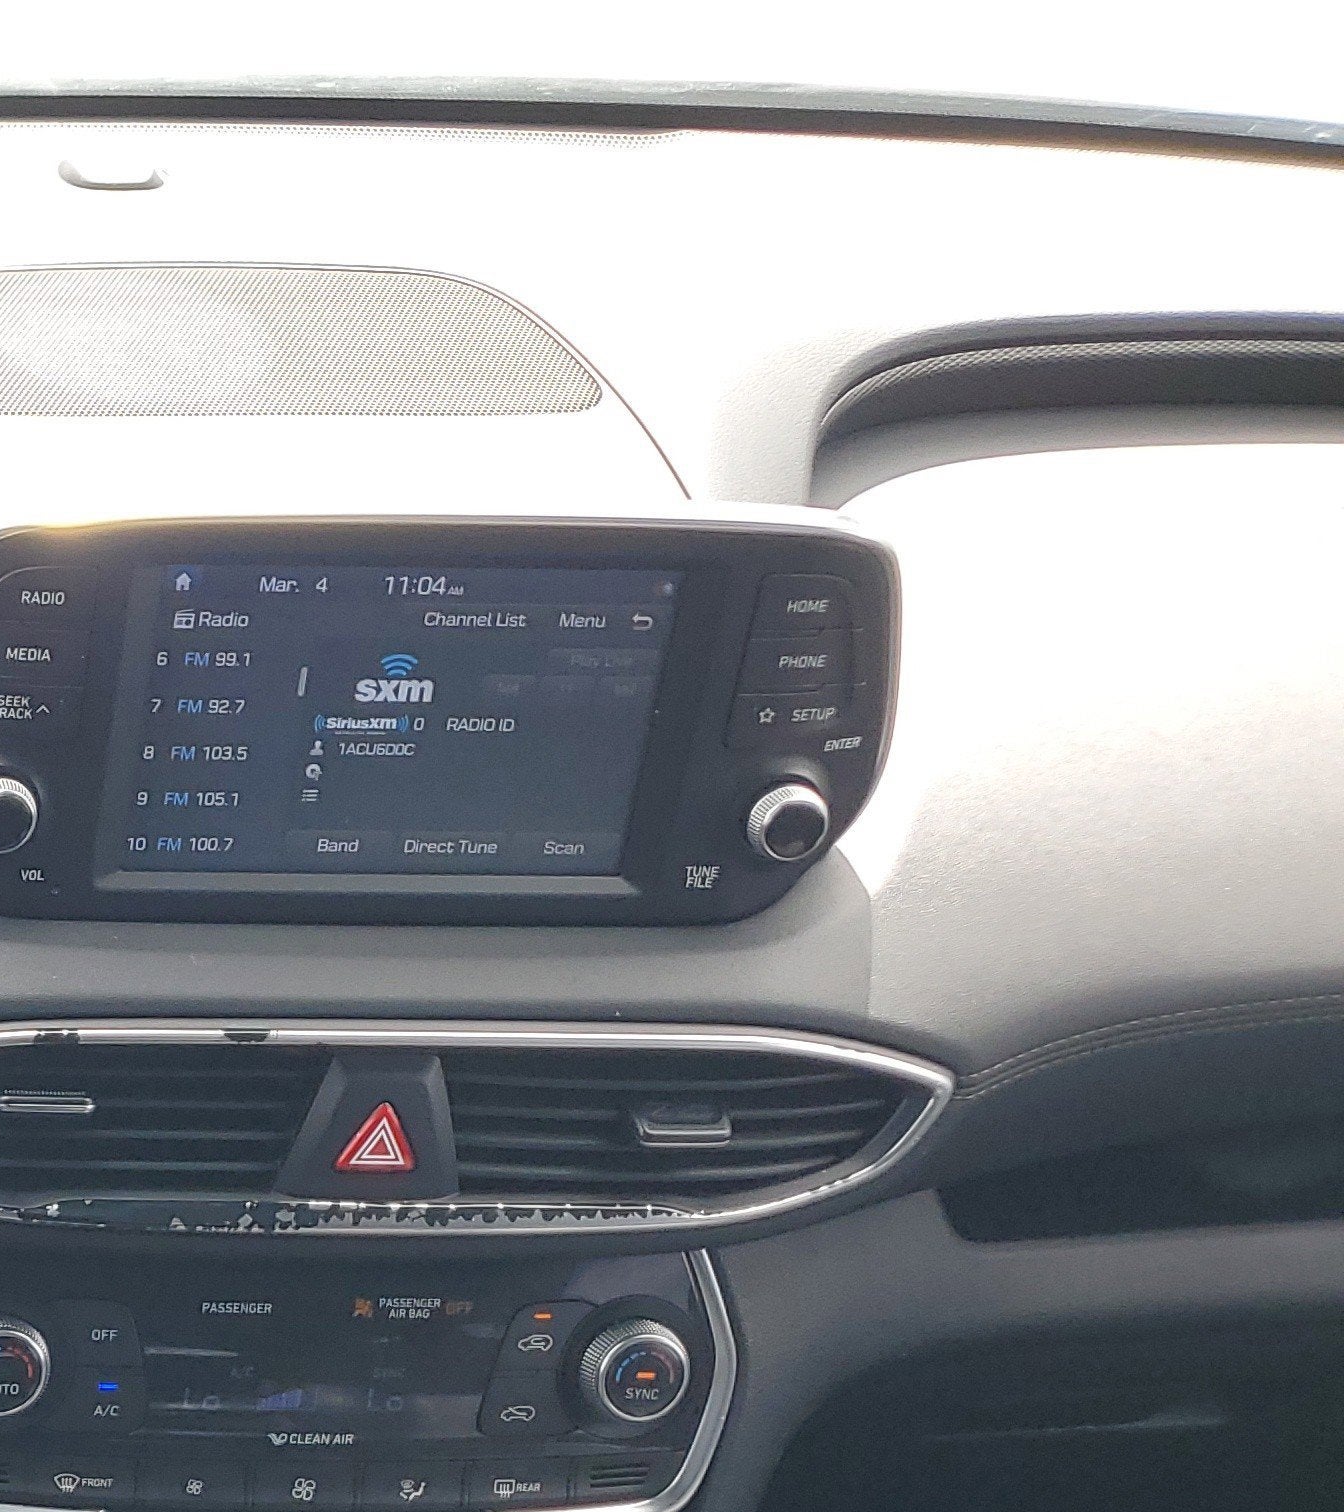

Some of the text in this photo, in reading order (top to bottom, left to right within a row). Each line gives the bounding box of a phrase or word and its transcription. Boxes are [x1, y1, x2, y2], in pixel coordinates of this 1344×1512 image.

[259, 577, 328, 593] Mar. 4
[21, 591, 65, 605] RADIO
[787, 600, 830, 613] HOME
[198, 611, 249, 628] Radio
[423, 611, 527, 628] Channel List
[559, 613, 606, 629] Menu
[6, 648, 51, 661] MEDIA
[156, 652, 251, 667] 6 FM 99.1
[778, 655, 828, 669] PHONE
[354, 678, 435, 703] sxm
[150, 699, 246, 714] 7 FM 92.7
[791, 707, 837, 722] SETUP
[446, 717, 496, 732] RADIO
[498, 718, 515, 732] ID
[824, 736, 863, 752] ENTER
[143, 745, 248, 761] 8 FM 103.5
[137, 791, 239, 807] 9 FM 105.1
[127, 837, 235, 852] 10 FM 100.7
[317, 838, 360, 853] Band
[404, 840, 498, 854] Direct Tune
[543, 842, 585, 855] Scan
[21, 869, 45, 882] VOL
[685, 865, 721, 878] TUNE
[685, 877, 714, 889] FILE
[202, 1302, 272, 1315] PASSENGER
[379, 1298, 441, 1309] PASSENGER
[388, 1309, 430, 1319] AIR BAG
[91, 1329, 118, 1342] OFF
[625, 1387, 660, 1402] SYNC
[93, 1405, 121, 1417] A/C
[289, 1433, 355, 1447] CLEAN AIR
[81, 1478, 113, 1489] FRONT
[515, 1482, 541, 1493] REAR
